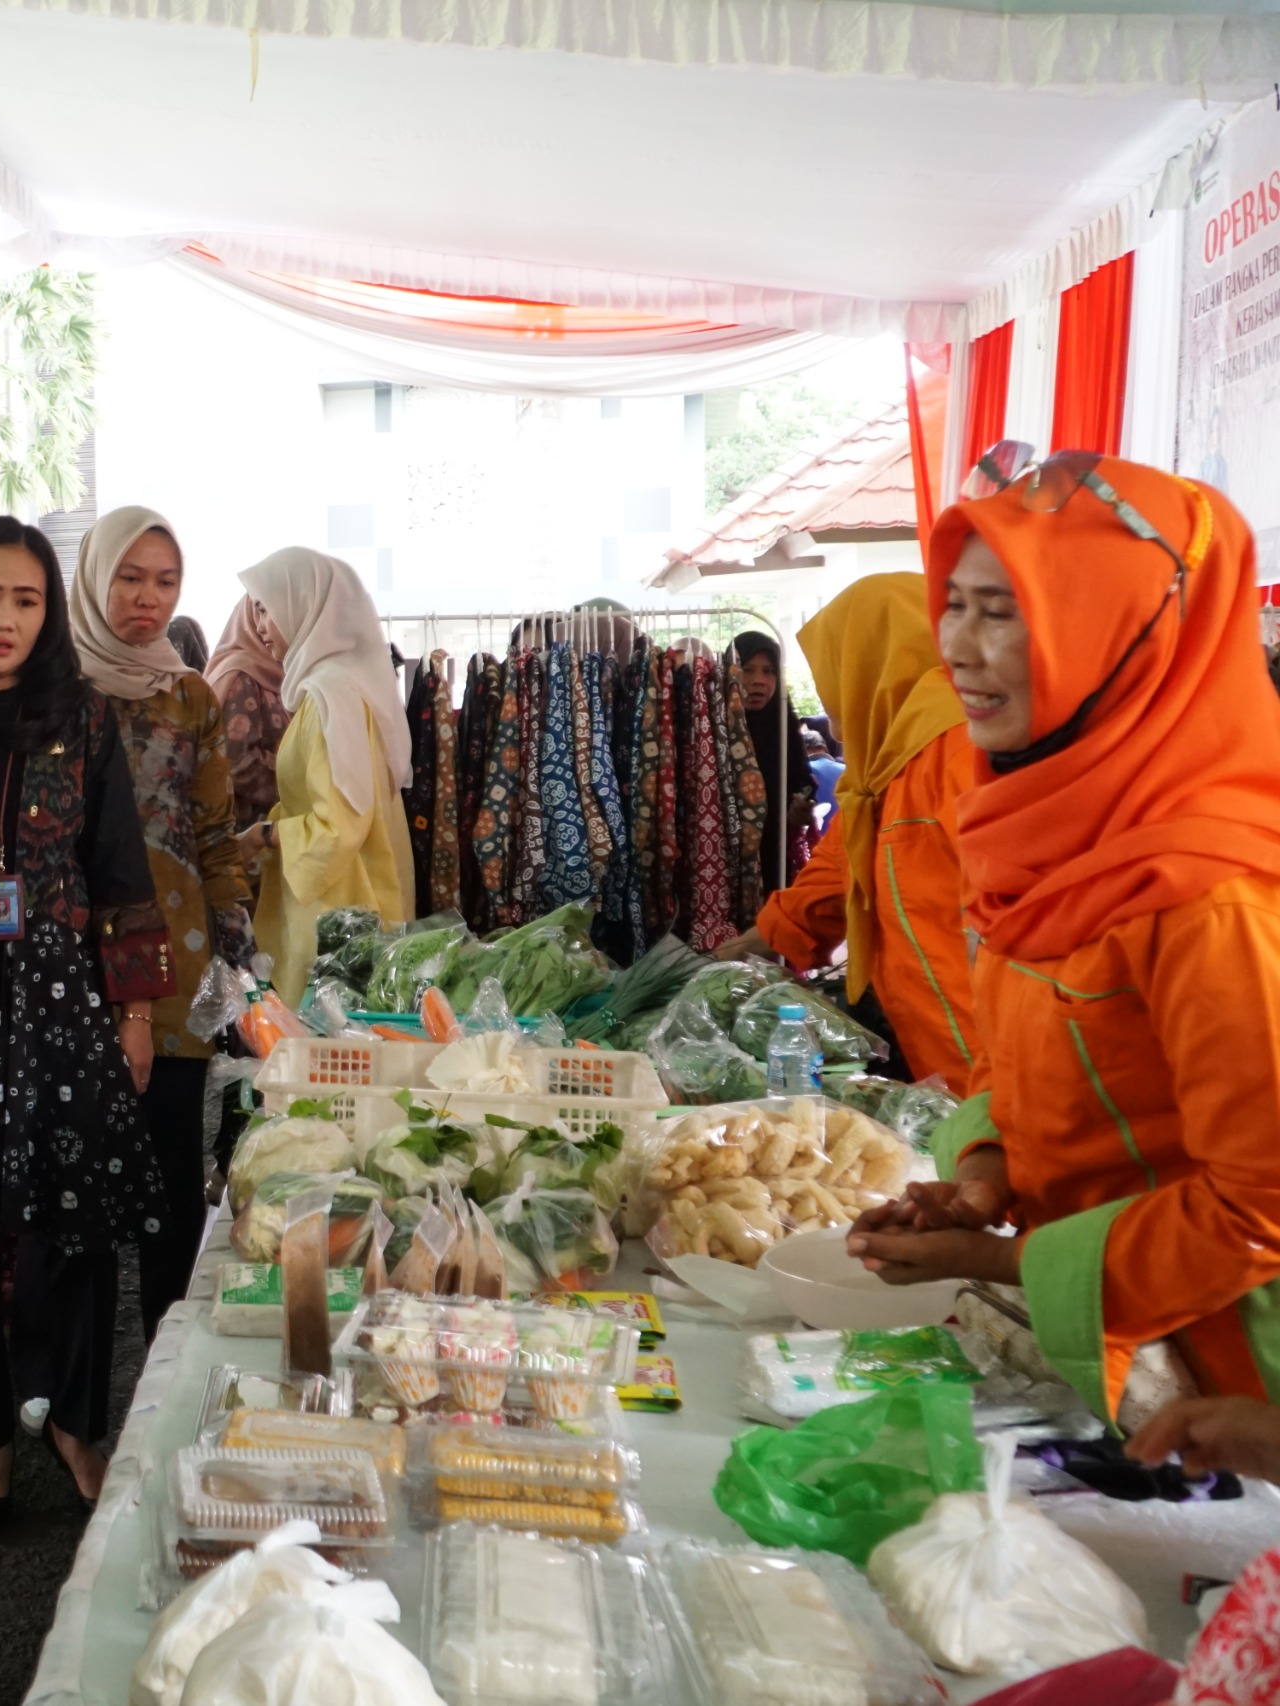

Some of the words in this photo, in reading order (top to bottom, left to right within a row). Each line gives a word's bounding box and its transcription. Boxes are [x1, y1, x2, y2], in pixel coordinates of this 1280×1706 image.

[1204, 170, 1280, 264] OPERAS
[1194, 280, 1223, 319] DALAM
[1225, 257, 1261, 302] RANGKA
